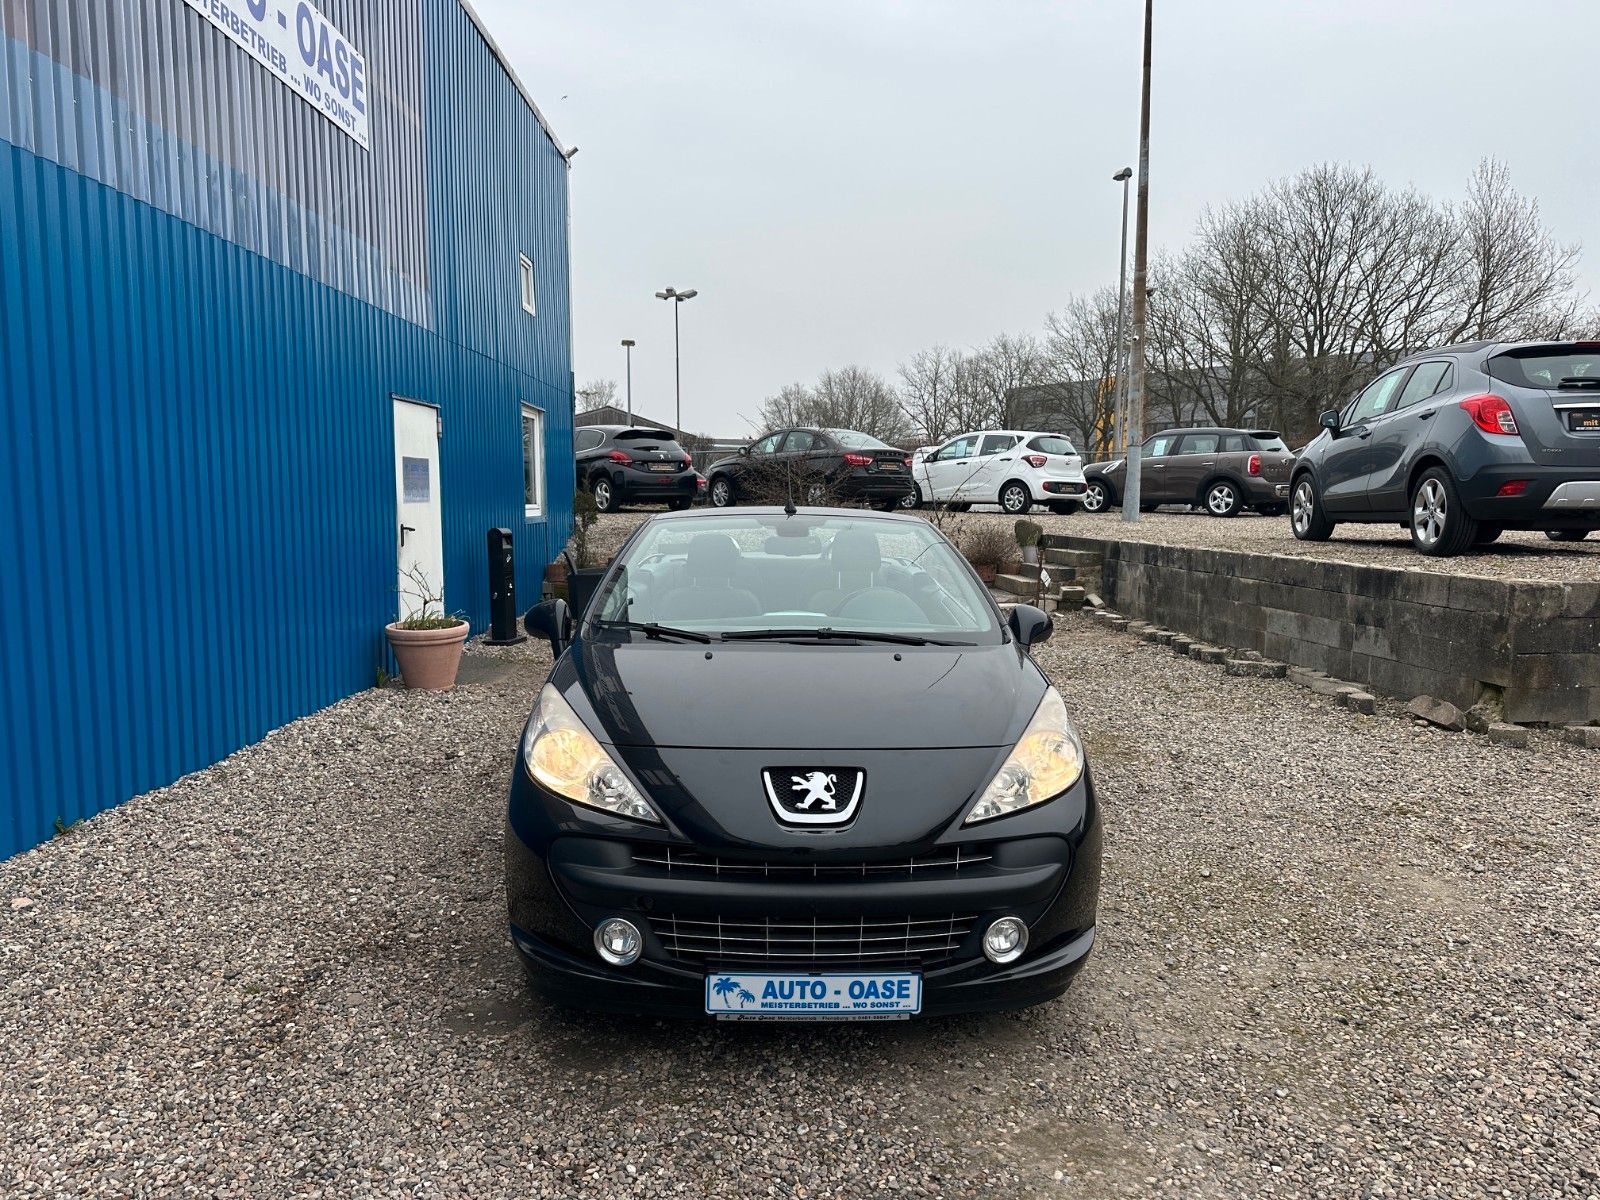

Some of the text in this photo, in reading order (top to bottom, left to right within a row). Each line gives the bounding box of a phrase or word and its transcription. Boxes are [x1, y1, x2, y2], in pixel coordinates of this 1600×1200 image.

[296, 3, 365, 116] OASE
[303, 74, 321, 103] WO
[324, 92, 356, 132] SONST
[760, 1001, 840, 1009] MEISTERBETRIEB
[853, 1001, 867, 1009] WO
[761, 980, 827, 1000] AUTO
[848, 979, 911, 1000] OASE
